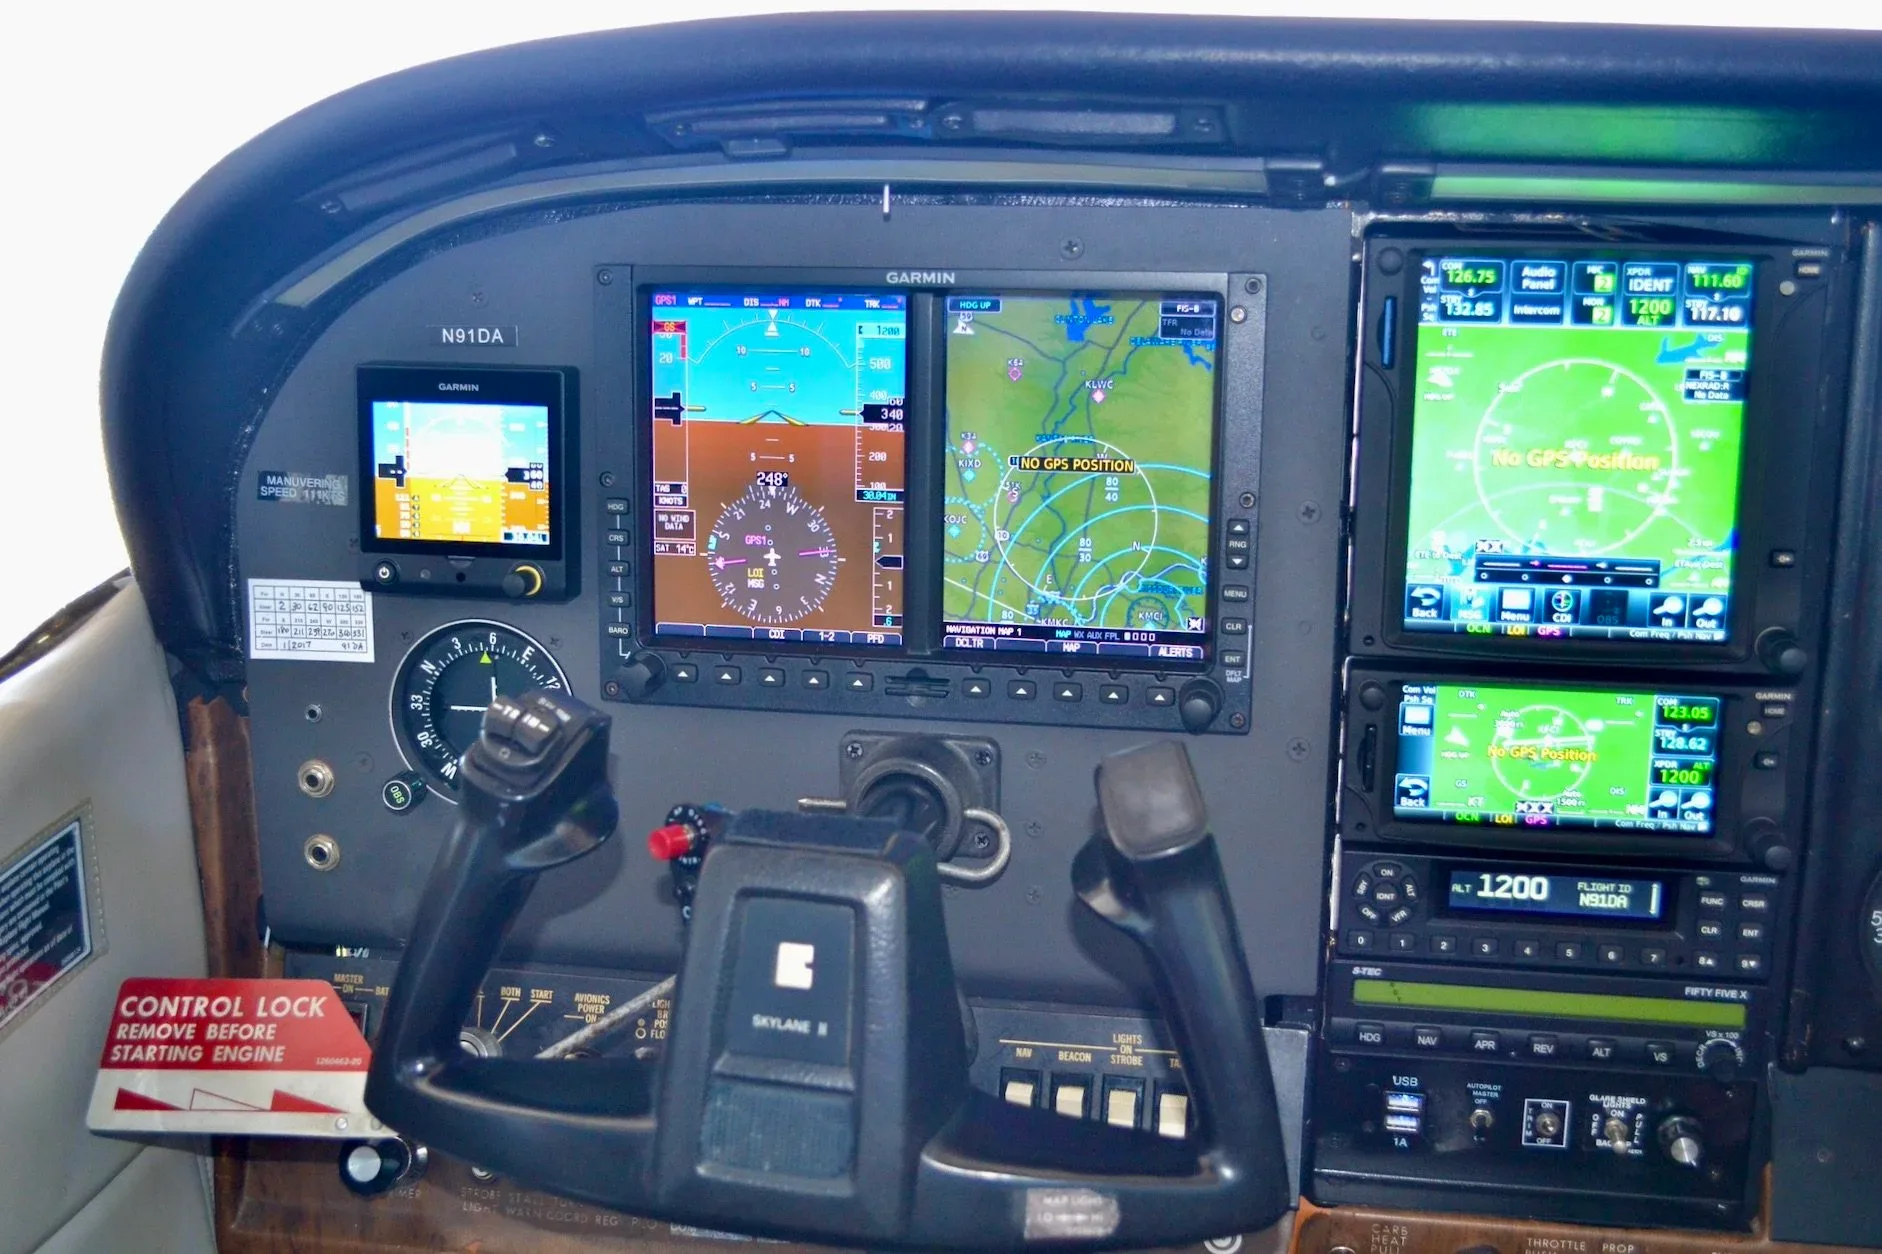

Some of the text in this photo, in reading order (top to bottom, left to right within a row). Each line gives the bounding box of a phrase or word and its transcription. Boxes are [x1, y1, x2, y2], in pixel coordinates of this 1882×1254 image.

[1447, 270, 1497, 283] 126.75
[1522, 266, 1556, 277] Audio
[886, 272, 955, 284] GARMIN
[1692, 274, 1741, 287] 111.60
[1522, 279, 1555, 290] Panel
[1629, 279, 1672, 292] IDENT
[960, 301, 990, 309] HDG UP
[1446, 303, 1494, 316] 132.85
[1514, 305, 1560, 315] Intercom
[1629, 299, 1671, 314] 1200
[1691, 308, 1741, 321] 117.10
[1637, 316, 1658, 325] ALT
[442, 328, 504, 344] N91DA
[659, 353, 673, 363] 20
[870, 359, 891, 369] 500
[439, 383, 479, 391] GARMIN
[1085, 380, 1113, 389] KLWC
[869, 452, 886, 461] 200
[1492, 450, 1659, 471] No GPS Position
[958, 459, 981, 468] KIXD
[1021, 458, 1134, 472] NO GPS POSITION
[261, 486, 296, 497] SPEED
[745, 535, 766, 545] GPS1
[748, 568, 764, 577] LOI
[1224, 590, 1247, 598] MENU
[352, 604, 364, 612] 152
[1412, 608, 1437, 619] Back
[1501, 612, 1529, 622] Menu
[1696, 618, 1716, 628] Out
[769, 630, 785, 639] CDI
[946, 625, 996, 635] NAVIGATION
[999, 627, 1015, 636] MAP
[1056, 630, 1071, 638] MAP
[1507, 625, 1525, 635] LOI
[1538, 626, 1560, 636] GPS
[489, 632, 496, 644] 6
[956, 638, 984, 649] DCLTR
[1063, 643, 1080, 652] MAP
[522, 645, 535, 660] E
[1159, 647, 1192, 657] ALERTS
[421, 660, 436, 674] N
[1403, 685, 1421, 694] Com
[411, 695, 423, 710] 33
[1663, 706, 1709, 719] 123.05
[1403, 726, 1430, 736] Menu
[417, 731, 432, 748] 30
[1660, 737, 1706, 750] 128.62
[1488, 744, 1597, 762] No GPS Position
[441, 762, 457, 779] W
[1660, 770, 1699, 784] 1200
[1400, 797, 1425, 807] Back
[1495, 814, 1513, 823] LOI
[1525, 815, 1547, 824] GPS
[1685, 812, 1703, 820] Out
[1615, 820, 1654, 829] Com Freq
[1741, 876, 1776, 884] GARMIN
[1452, 874, 1548, 900] ALT 1200
[1577, 882, 1631, 893] FLIGHT ID
[1377, 892, 1394, 900] IDNT
[1579, 893, 1628, 908] N91DA
[1701, 897, 1723, 905] FUNC
[1392, 910, 1407, 922] VFR
[1701, 926, 1717, 934] CLR
[1743, 929, 1758, 937] ENT
[334, 974, 363, 984] MASTER
[501, 987, 521, 997] BOTH
[531, 989, 553, 999] START
[1685, 987, 1747, 999] FIFTY FIVE X
[575, 993, 610, 1004] AVIONICS
[120, 996, 328, 1017] CONTROL LOCK
[578, 1004, 604, 1013] POWER
[652, 1000, 670, 1009] LIGH
[585, 1014, 597, 1023] ON
[752, 1014, 810, 1034] SKYLANE
[116, 1024, 277, 1040] REMOVE BEFORE
[1359, 1032, 1381, 1042] HDG
[1724, 1031, 1739, 1039] 100
[1113, 1034, 1142, 1044] LIGHTS
[1418, 1036, 1437, 1046] NAV
[1120, 1044, 1132, 1054] ON
[1475, 1040, 1495, 1049] APR
[1534, 1044, 1554, 1054] REV
[111, 1045, 203, 1062] STARTING
[213, 1046, 286, 1062] ENGINE
[1016, 1048, 1032, 1057] NAV
[1059, 1052, 1091, 1063] BEACON
[1593, 1048, 1611, 1057] ALT
[1654, 1052, 1667, 1061] VS
[1111, 1055, 1143, 1066] STROBE
[1170, 1058, 1182, 1068] TA
[1393, 1076, 1418, 1086] USB
[1467, 1083, 1501, 1091] AUTOPILOT
[1618, 1096, 1646, 1104] SHIELD
[1394, 1138, 1407, 1148] 1A
[1371, 1224, 1408, 1236] CARB
[1372, 1234, 1406, 1246] HEAT
[1527, 1238, 1634, 1253] THROTTLE PROP
